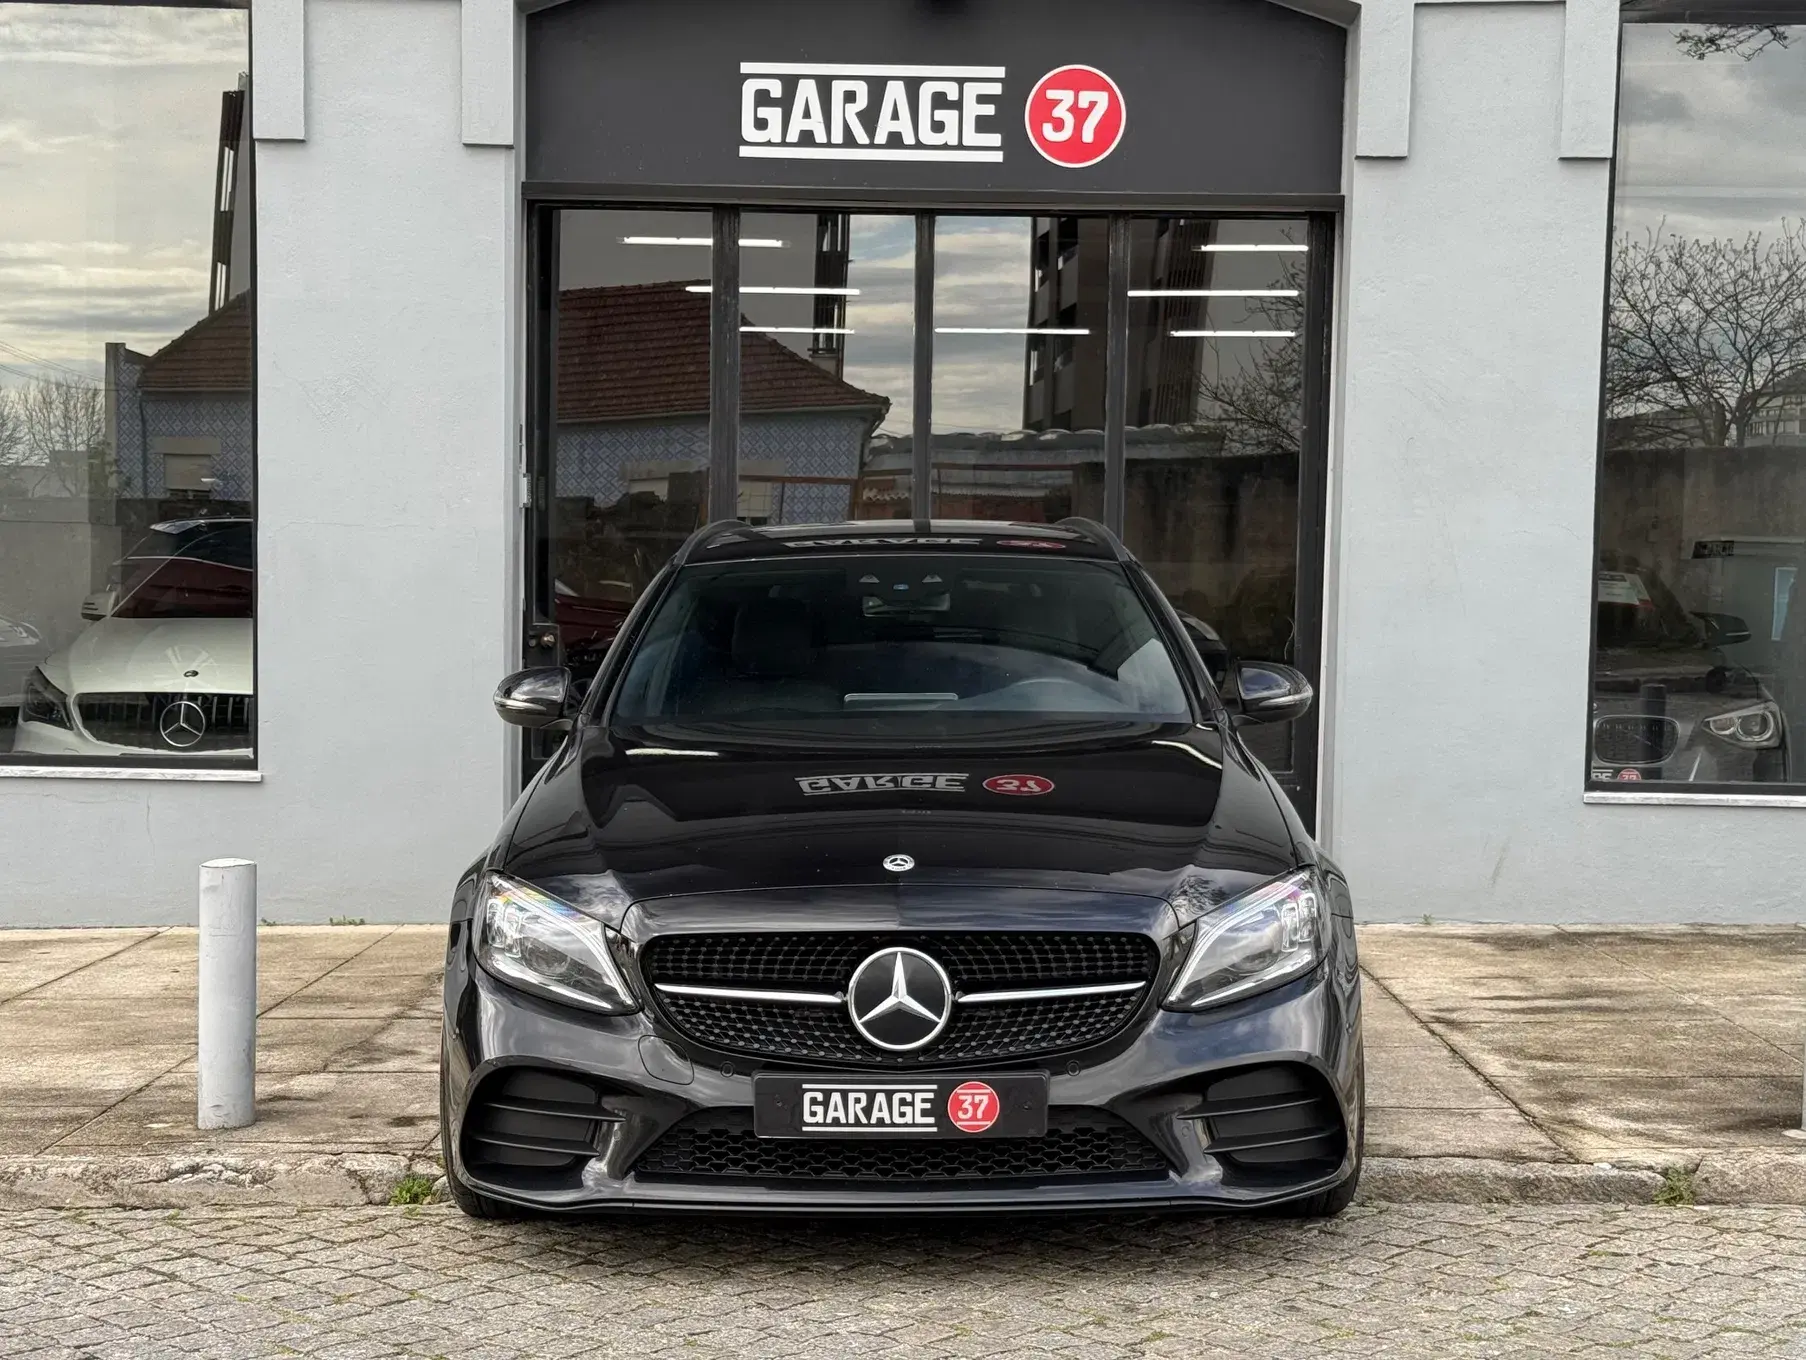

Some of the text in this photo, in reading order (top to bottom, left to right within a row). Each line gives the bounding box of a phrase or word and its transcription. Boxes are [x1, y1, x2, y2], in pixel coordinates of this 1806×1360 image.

[741, 78, 1110, 147] GARAGE 37
[802, 1091, 990, 1124] GARAGE 37
